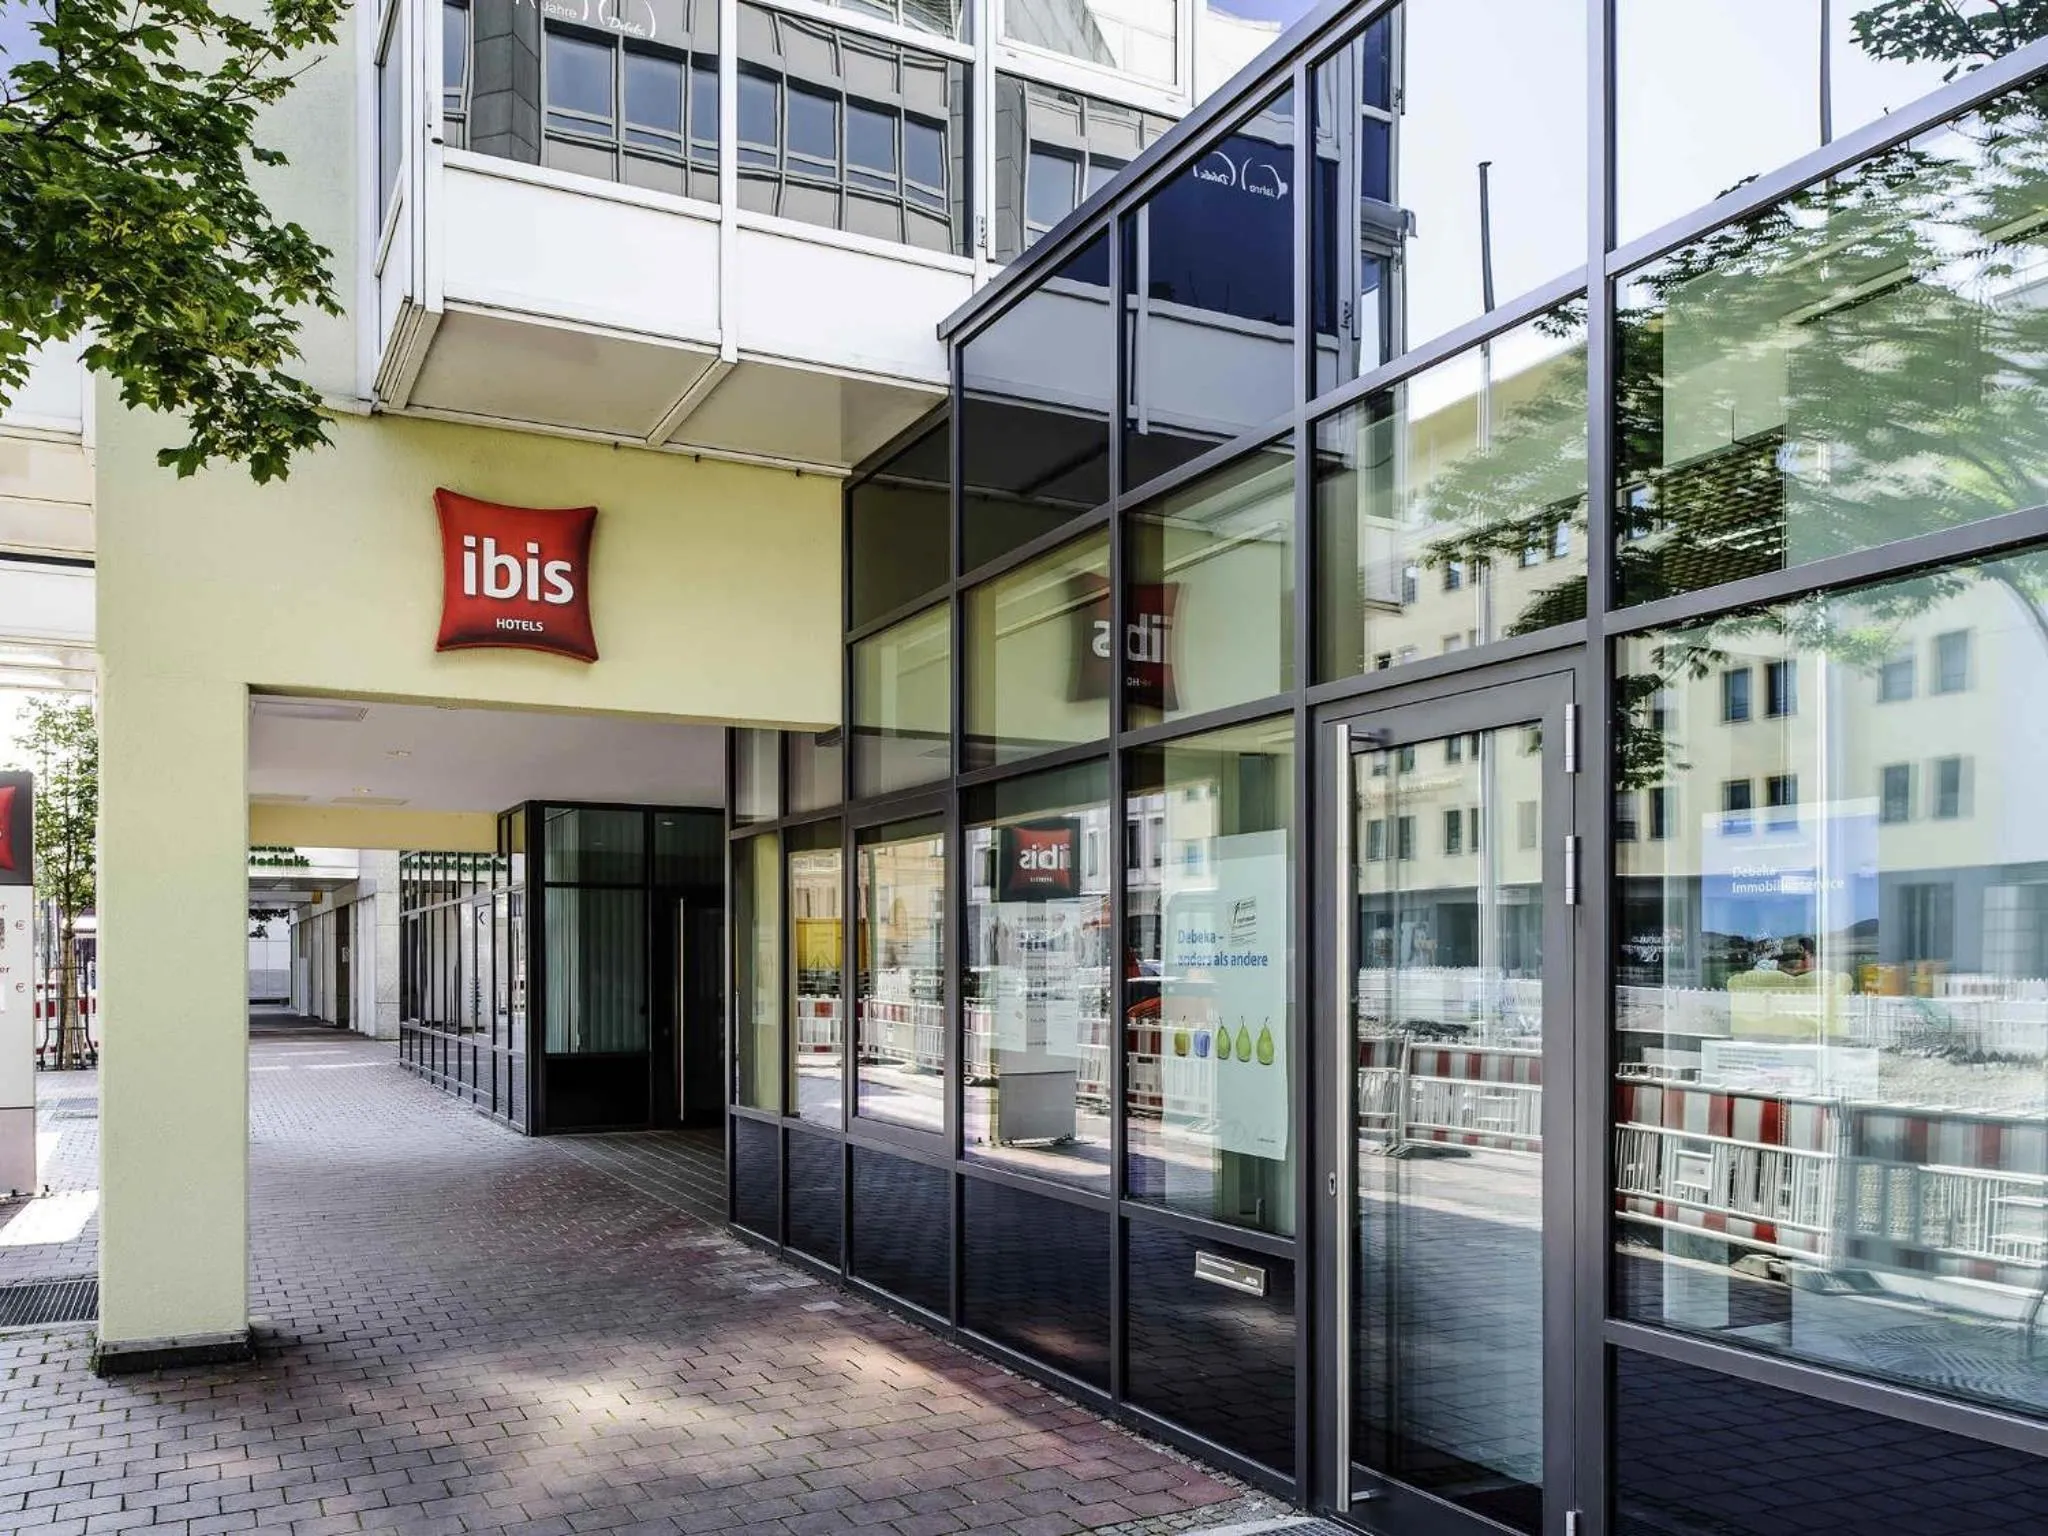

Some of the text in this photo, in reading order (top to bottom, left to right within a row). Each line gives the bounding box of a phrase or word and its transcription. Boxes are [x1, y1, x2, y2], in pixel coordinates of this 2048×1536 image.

[541, 1, 577, 19] Jahre
[463, 535, 574, 604] ibis
[496, 618, 544, 632] HOTELS
[1177, 929, 1216, 944] Debeka
[1177, 950, 1268, 967] anders als andere
